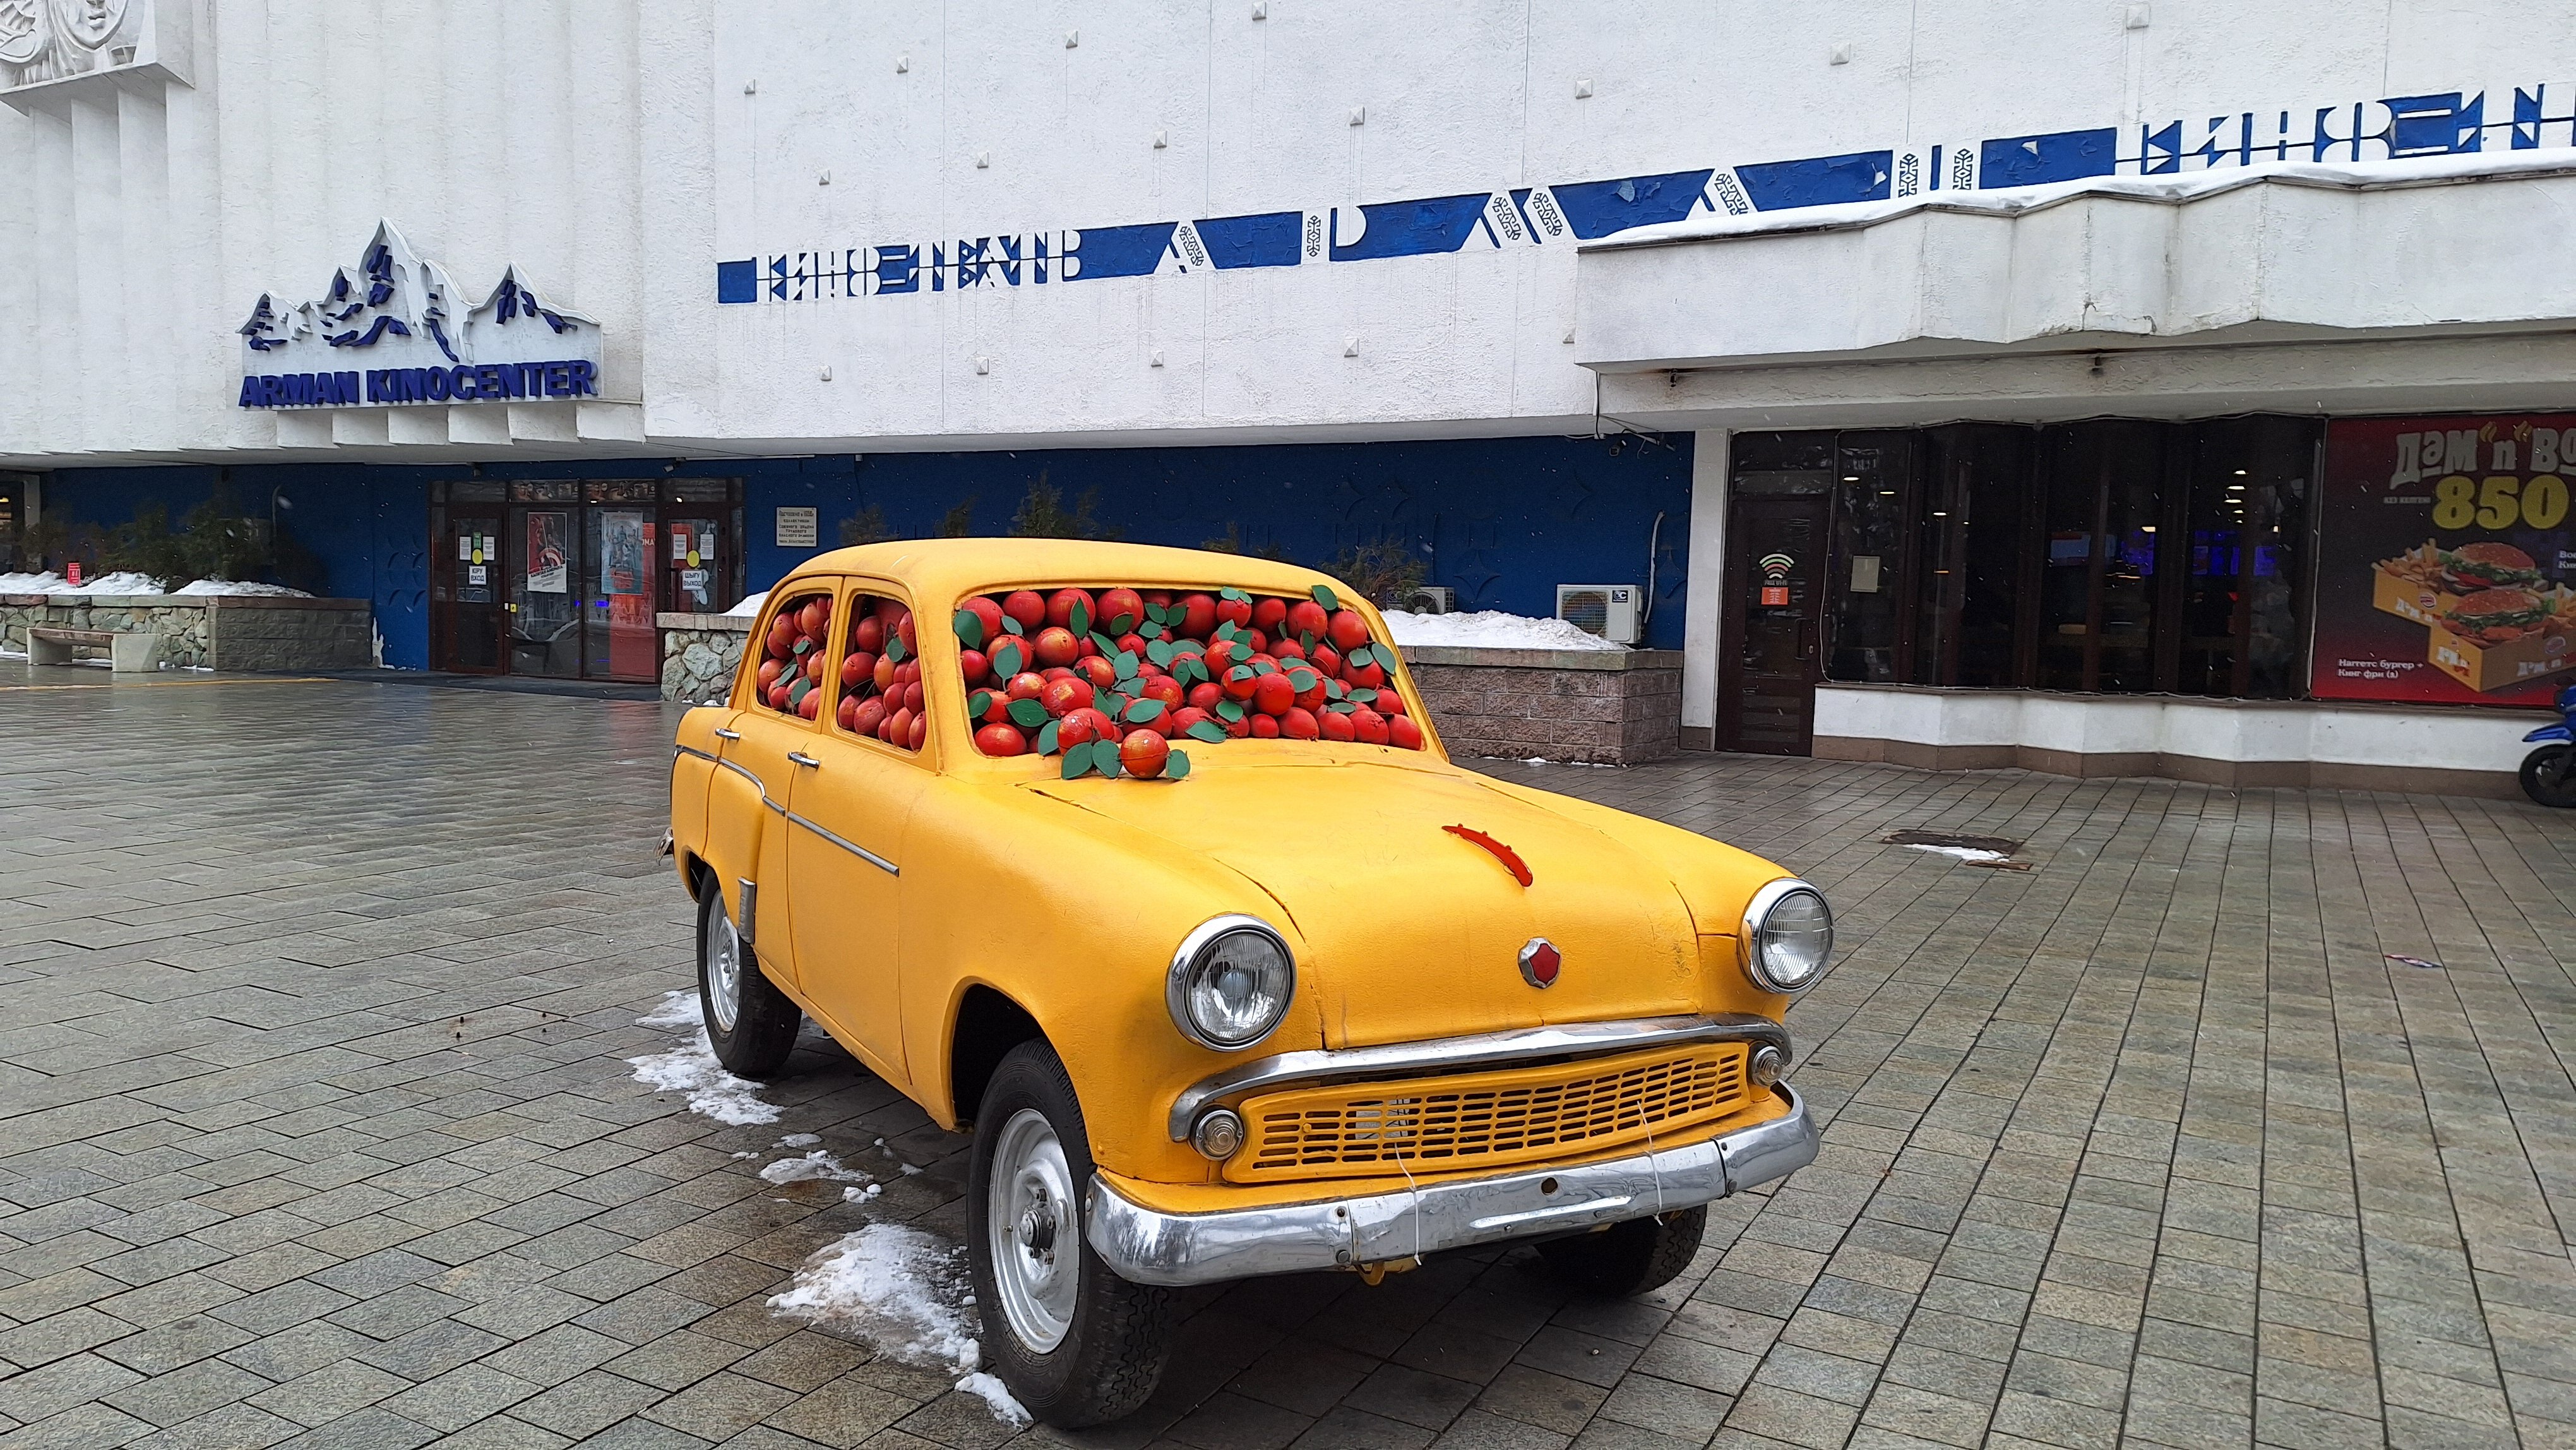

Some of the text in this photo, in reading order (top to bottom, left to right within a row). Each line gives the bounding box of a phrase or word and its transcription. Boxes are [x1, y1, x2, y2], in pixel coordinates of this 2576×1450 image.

[239, 359, 599, 407] ARMAN KINOCENTER
[2432, 475, 2570, 530] 850
[2363, 669, 2385, 679] фри
[2380, 659, 2415, 670] бургер
